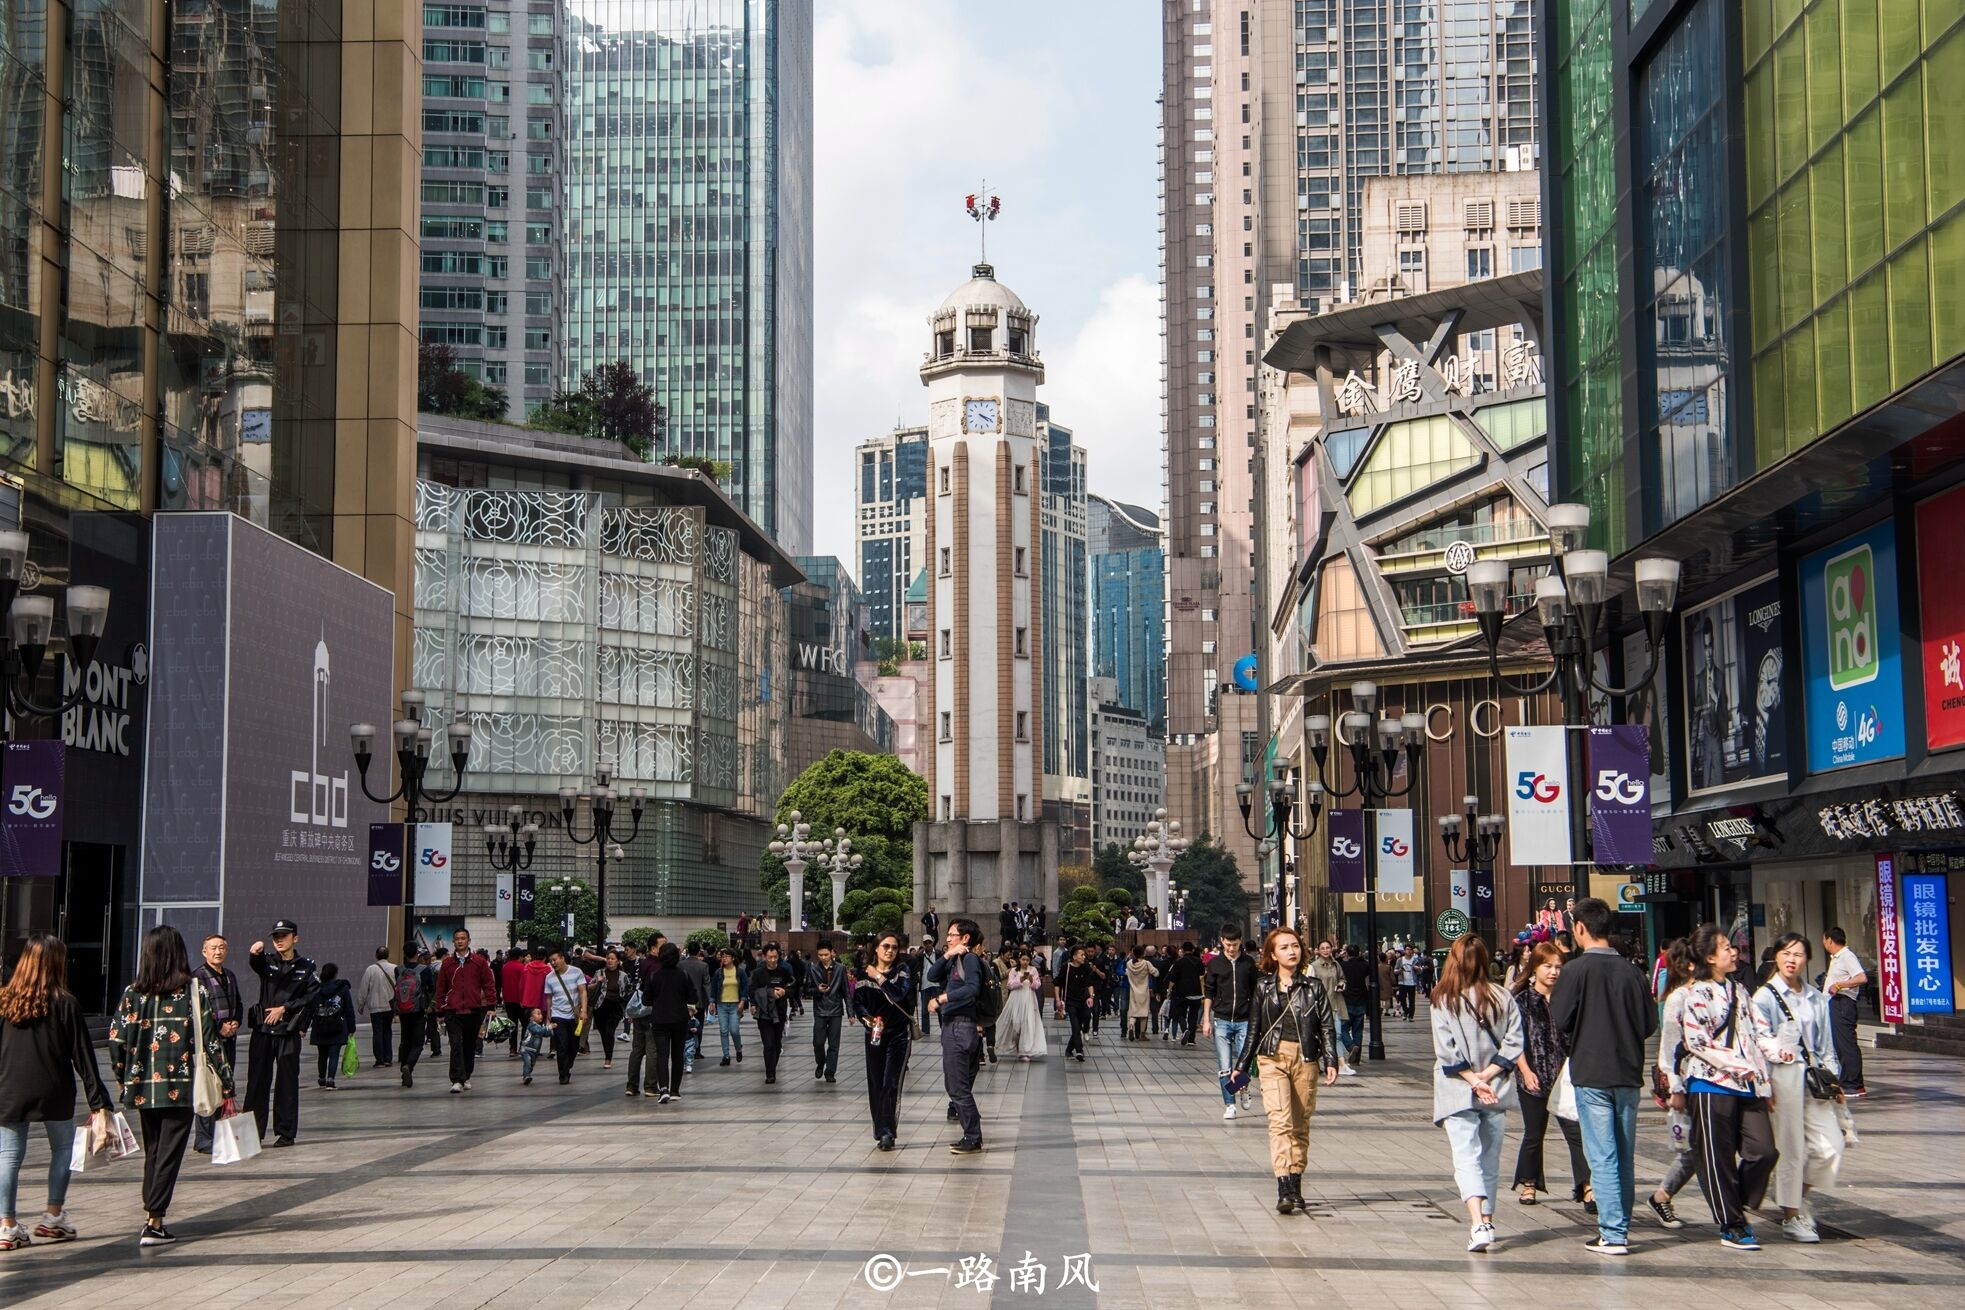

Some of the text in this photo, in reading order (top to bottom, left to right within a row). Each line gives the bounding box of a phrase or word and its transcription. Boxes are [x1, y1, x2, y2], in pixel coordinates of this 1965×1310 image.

[1334, 338, 1536, 412] 金鹰财富
[799, 642, 846, 677] WFC
[62, 652, 132, 710] MONT
[60, 701, 131, 757] BLANC
[1831, 736, 1855, 752] 中国移动
[290, 769, 349, 828] cbd
[1516, 772, 1560, 804] 5G
[1596, 770, 1645, 805] 5G
[8, 785, 57, 819] 5G
[415, 807, 562, 829] OUIS VUITON
[1707, 818, 1756, 839] LONGINES
[282, 829, 355, 851] 重庆 解放碑中央商务区
[1331, 836, 1361, 859] 5G
[1381, 836, 1409, 857] 5G
[371, 850, 401, 872] 5G
[420, 848, 447, 868] 5G
[499, 889, 511, 900] 5G
[520, 889, 534, 901] 5G
[1452, 885, 1466, 897] 5G
[1476, 885, 1492, 899] 5G
[1540, 885, 1576, 893] GUCCI
[1877, 860, 1900, 1002] 眼镜批发中心
[1913, 883, 1942, 992] 眼镜批发中心
